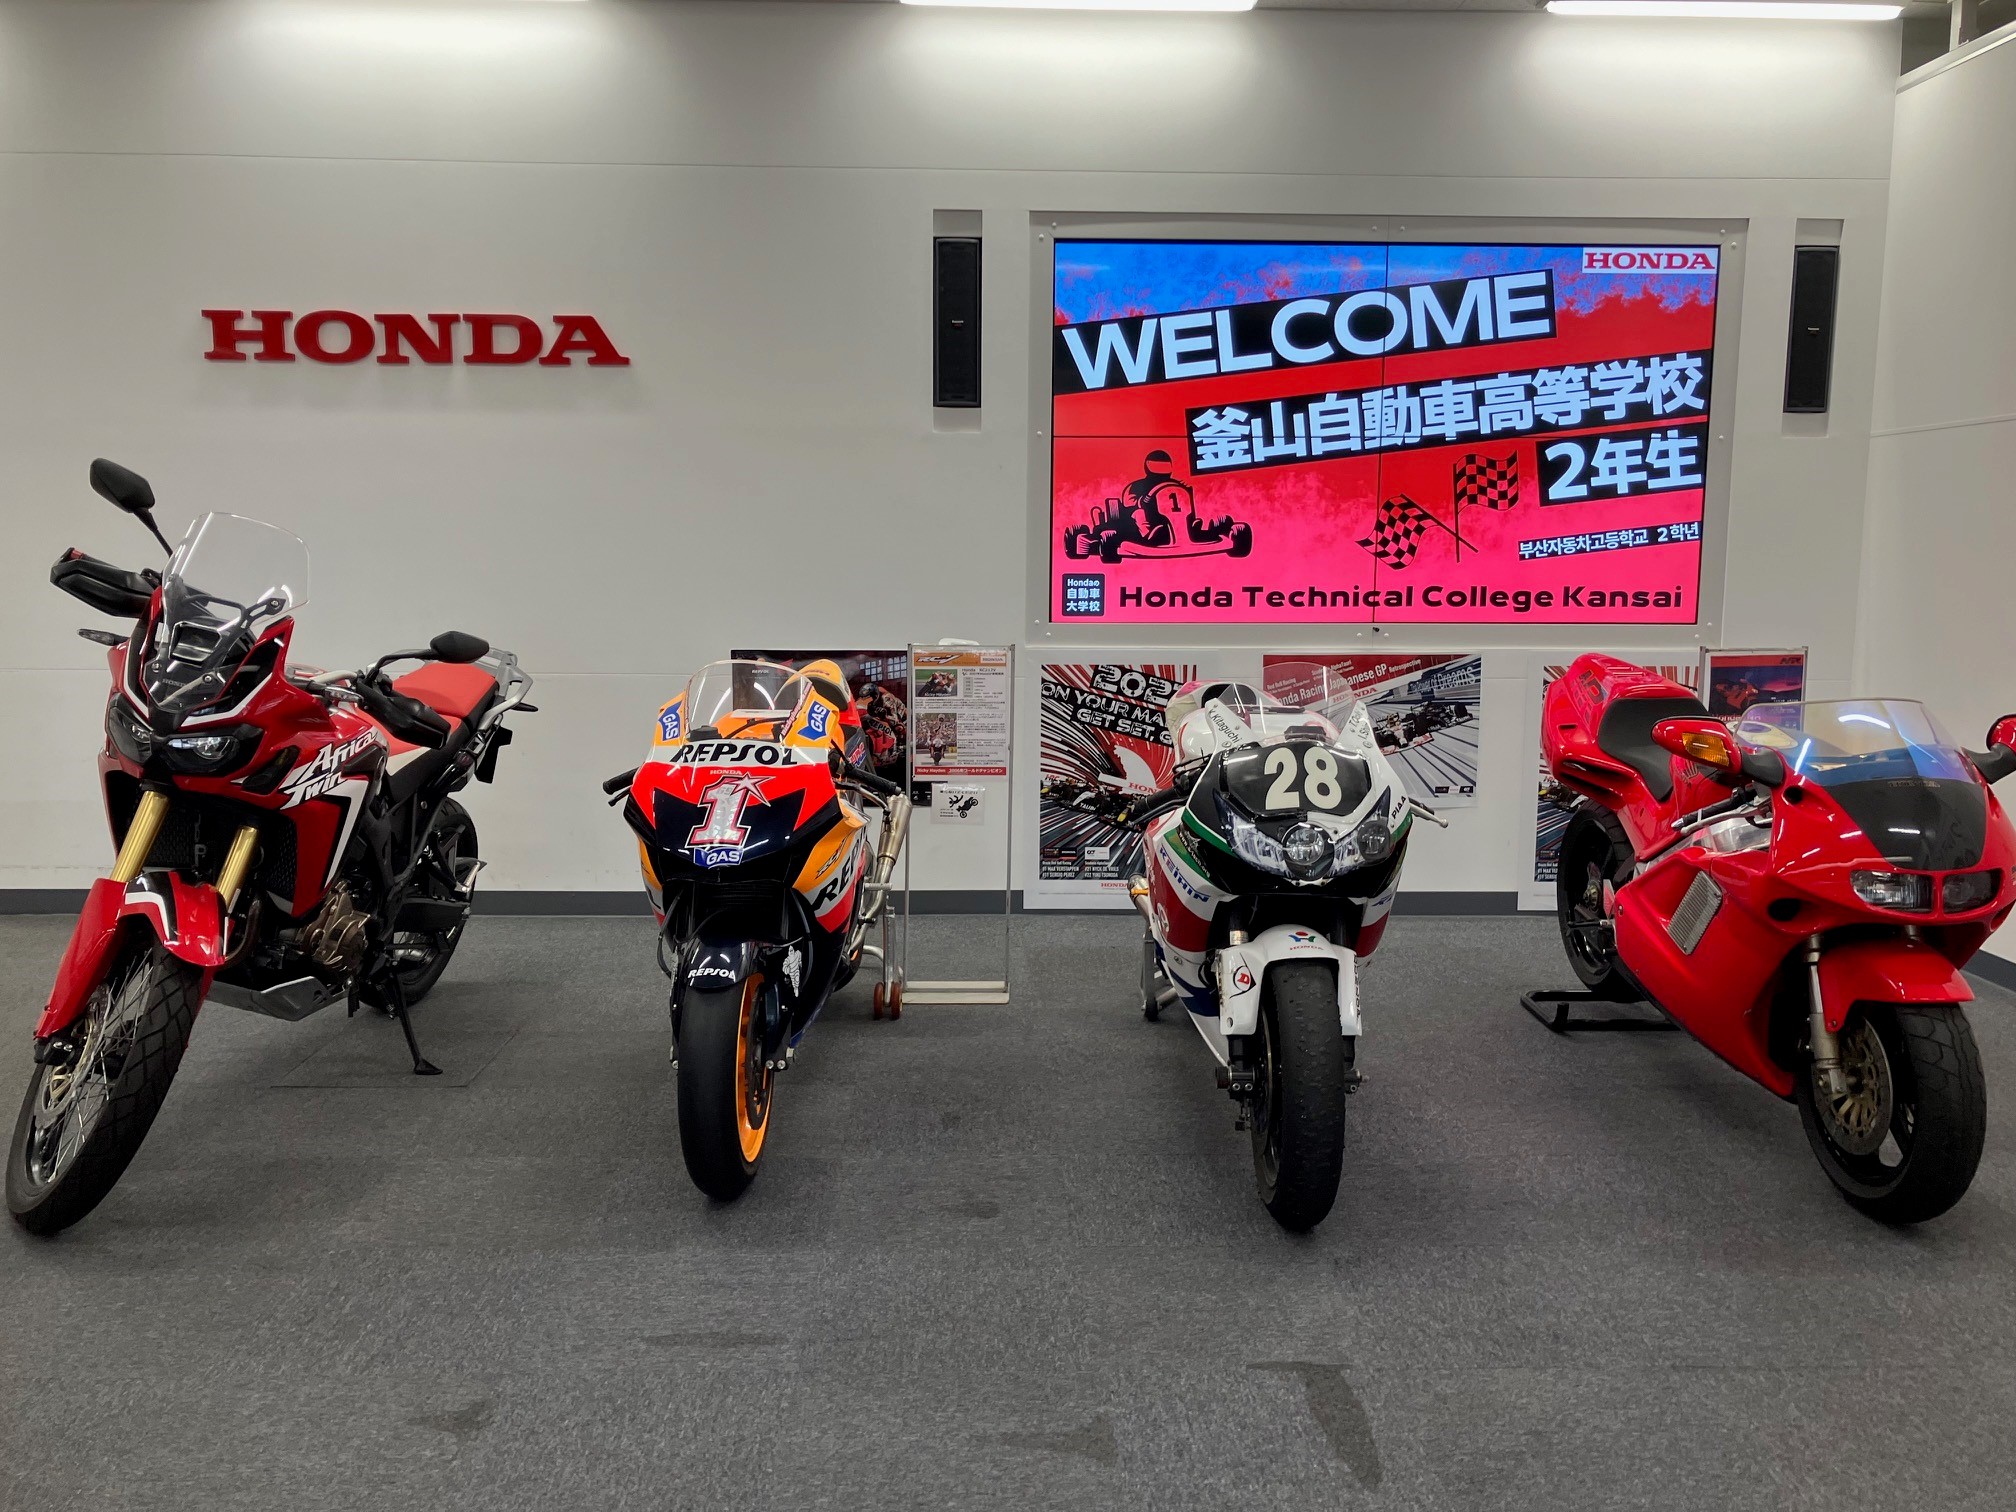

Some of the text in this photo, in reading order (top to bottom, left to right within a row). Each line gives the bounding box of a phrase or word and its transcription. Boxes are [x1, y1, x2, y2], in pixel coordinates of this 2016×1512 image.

[1584, 252, 1716, 270] HONDA
[201, 309, 631, 366] HONDA
[1061, 273, 1551, 390] WELCOME
[1192, 354, 1705, 470] 釜山自動車高等学校
[1545, 436, 1703, 500] 2年生
[1168, 493, 1181, 512] 1
[1519, 529, 1648, 559] 부산자동차고등학교
[1066, 588, 1100, 599] 自動車
[1067, 578, 1100, 587] Hondaの
[1066, 600, 1100, 612] 大学校
[1120, 585, 1682, 612] Honda Technical College Kansai
[1375, 663, 1387, 677] GP
[1093, 664, 1183, 708] 202
[1041, 681, 1170, 727] ON YOUR MA
[1076, 708, 1115, 727] GET
[662, 713, 680, 740] GAS
[810, 704, 827, 733] GAS
[296, 731, 378, 785] Africa
[670, 743, 798, 766] REPSOL
[280, 771, 349, 810] Twin
[1264, 747, 1342, 810] 28
[685, 774, 752, 849] 1
[1391, 796, 1407, 820] PIAA
[706, 850, 741, 866] GAS
